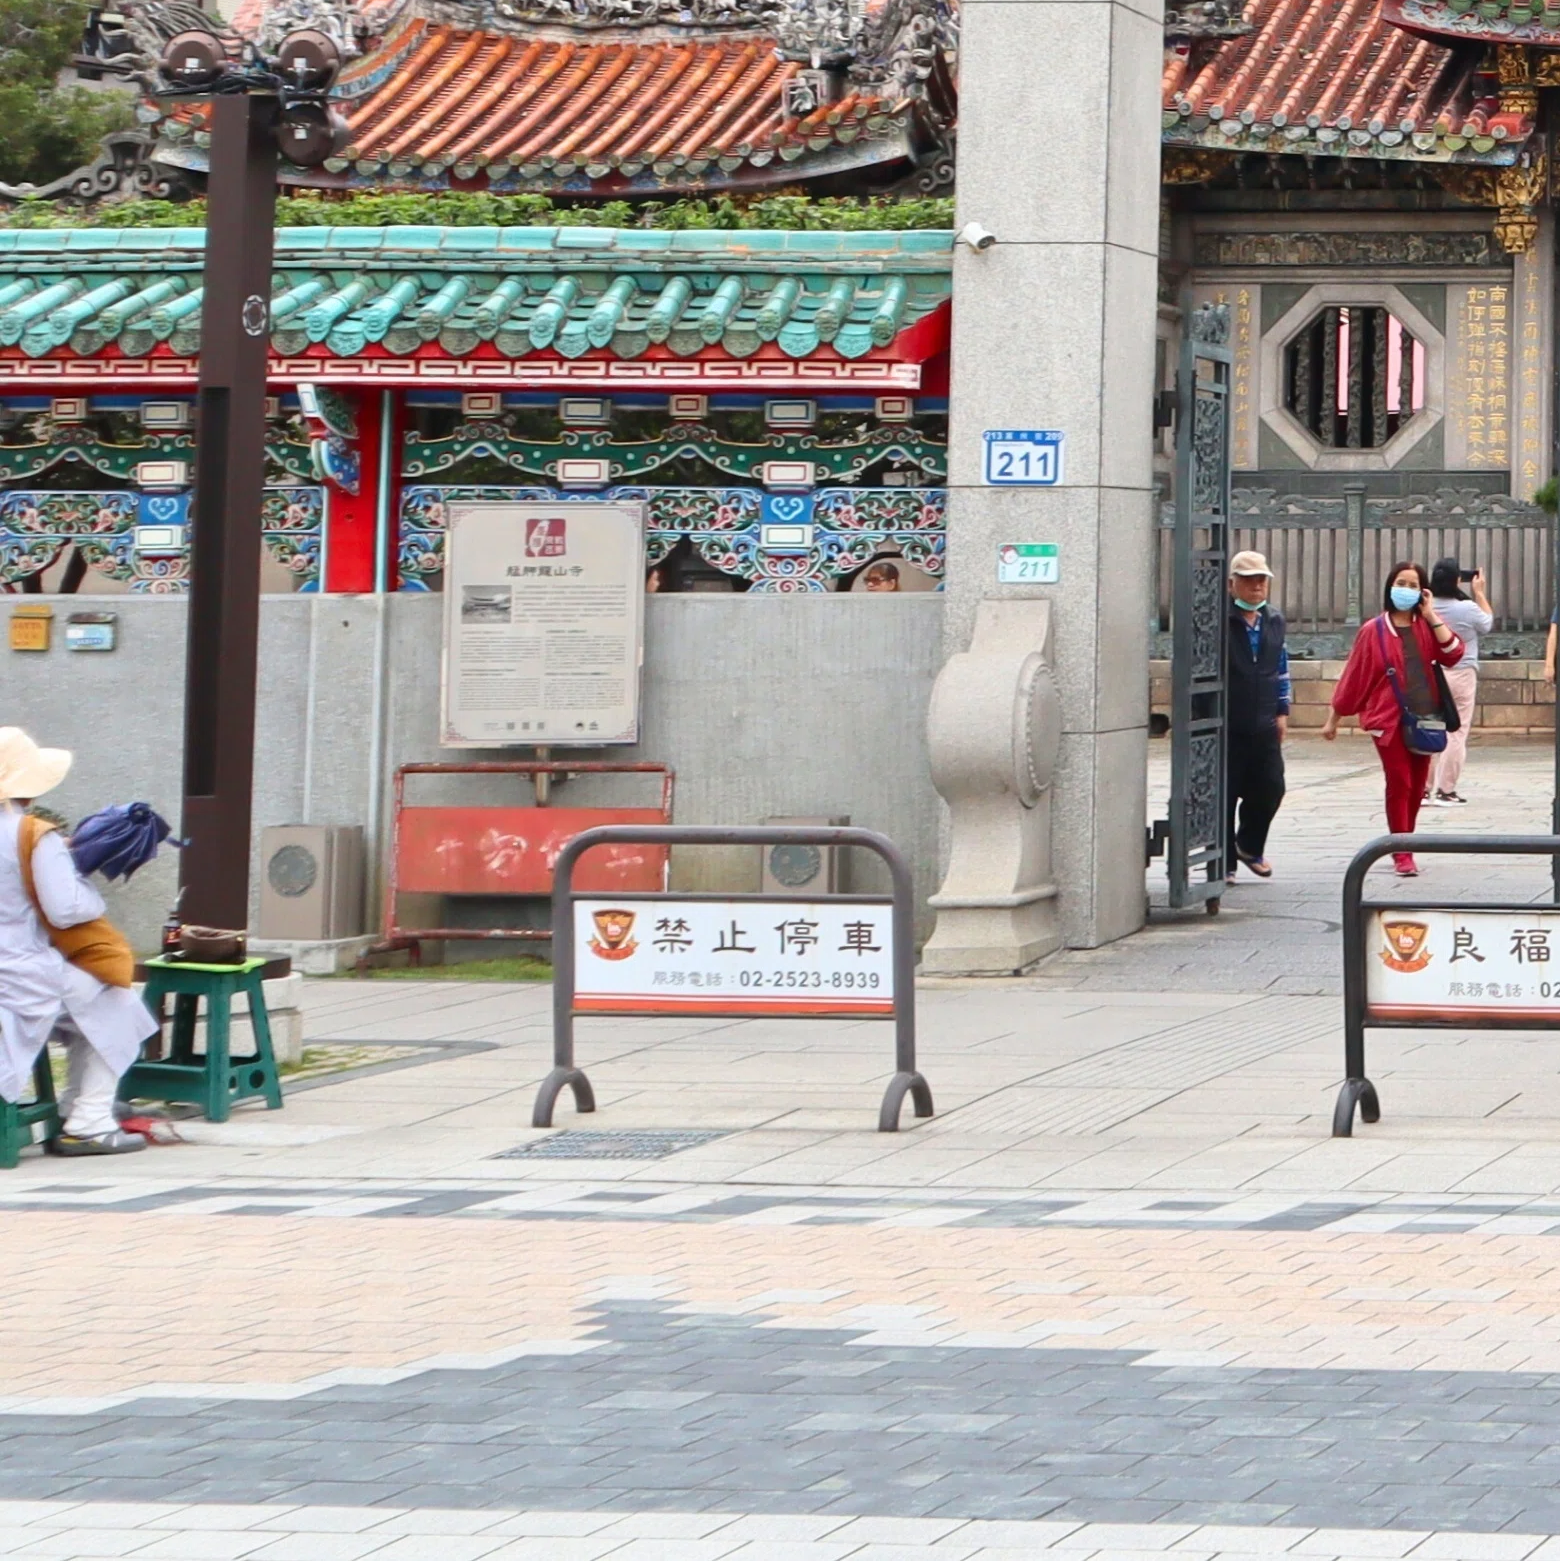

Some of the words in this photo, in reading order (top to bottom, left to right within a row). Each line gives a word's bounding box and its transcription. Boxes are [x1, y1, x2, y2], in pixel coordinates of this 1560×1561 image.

[996, 451, 1050, 477] 211
[1017, 561, 1052, 578] 211
[651, 917, 883, 957] 禁止停車
[739, 970, 881, 990] 02-2523-8939
